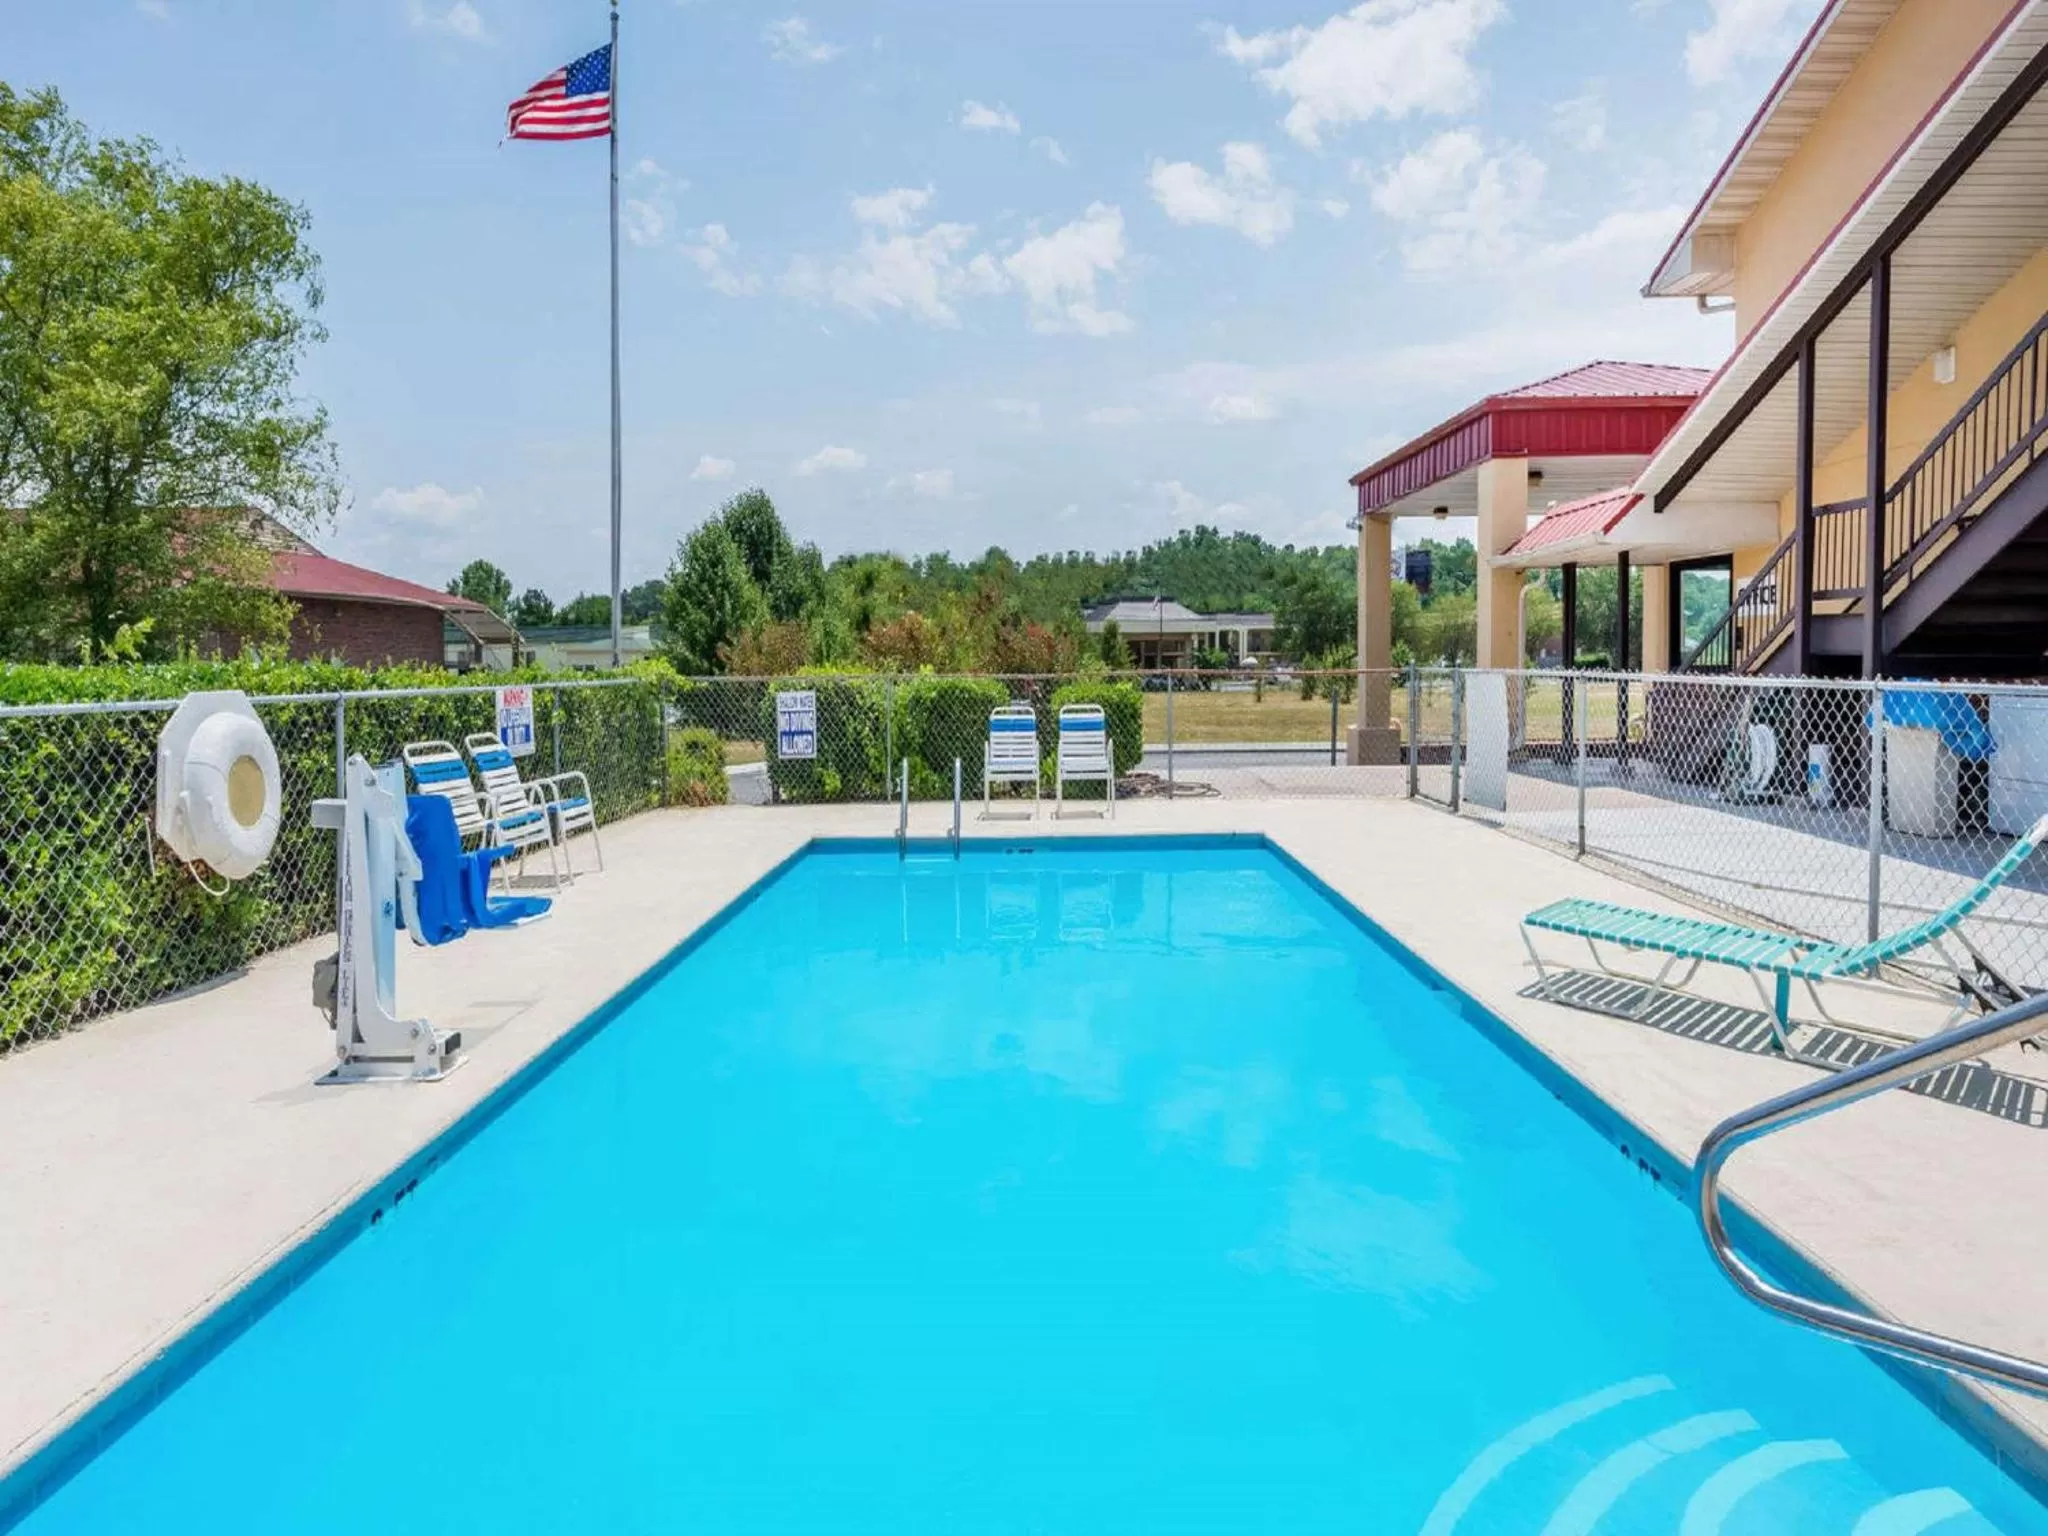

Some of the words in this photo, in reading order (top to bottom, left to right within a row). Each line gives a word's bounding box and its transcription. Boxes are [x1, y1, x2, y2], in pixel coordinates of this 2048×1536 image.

[1738, 585, 1776, 605] FICE
[780, 712, 789, 731] NO
[790, 712, 814, 731] DIVING
[782, 735, 813, 753] ALLOWED
